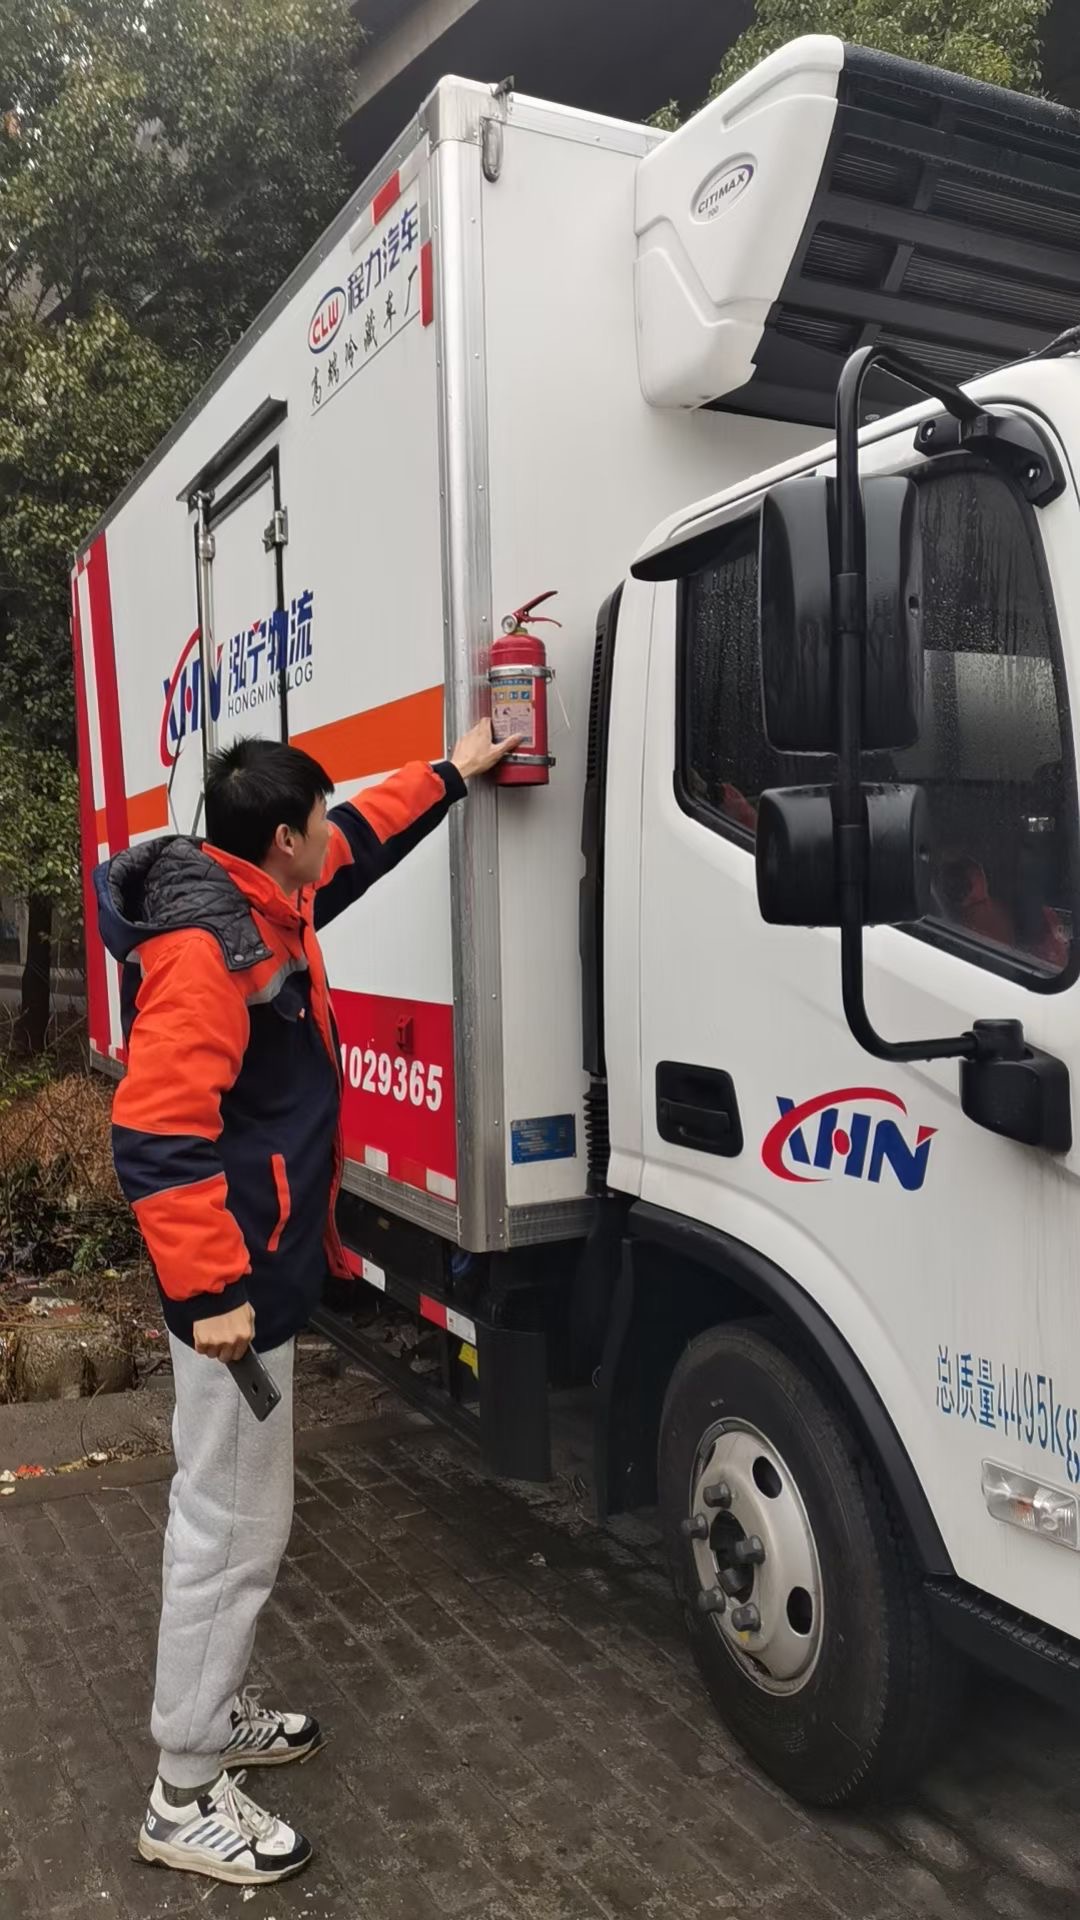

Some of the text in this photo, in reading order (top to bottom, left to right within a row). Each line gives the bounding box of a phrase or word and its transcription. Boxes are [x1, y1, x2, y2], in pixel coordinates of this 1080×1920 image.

[698, 170, 746, 214] CITIMAX
[347, 202, 419, 316] 程力汽车
[311, 297, 339, 345] CLW
[228, 589, 314, 696] 泓宁物流
[935, 1343, 1080, 1484] 总质量4495kg
